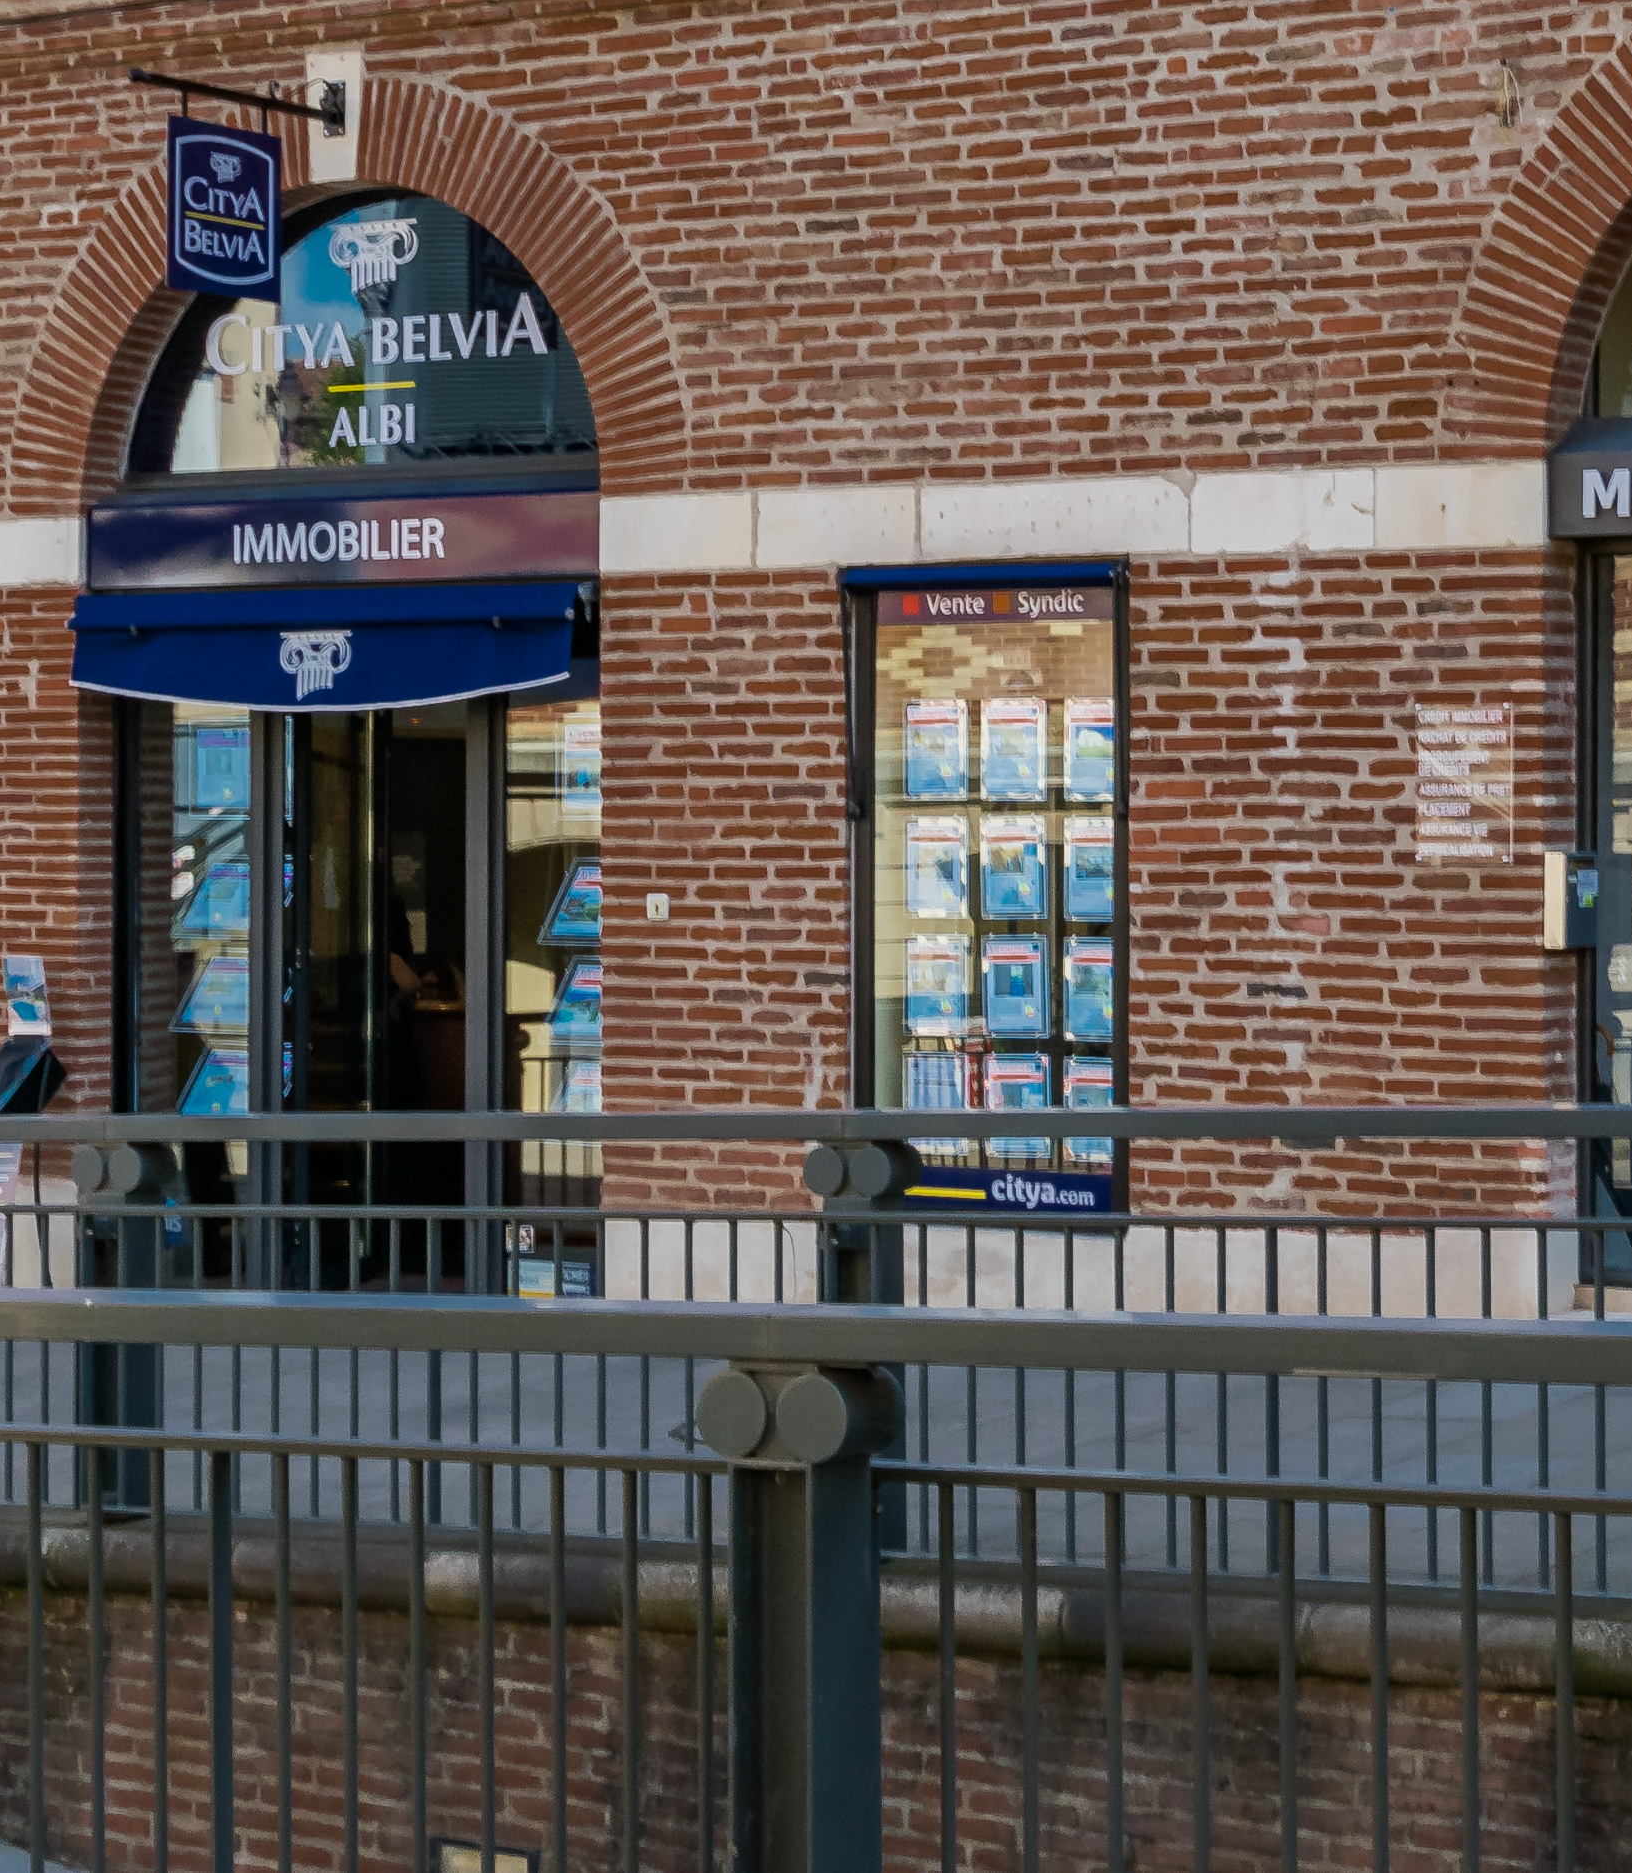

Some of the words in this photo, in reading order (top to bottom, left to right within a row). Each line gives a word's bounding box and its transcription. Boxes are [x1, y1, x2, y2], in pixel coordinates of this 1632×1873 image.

[183, 176, 265, 223] CITYA
[183, 220, 265, 266] BELVIA
[206, 313, 355, 376] CITYA
[372, 292, 548, 366] BELVIA
[329, 403, 415, 448] ALBI
[233, 518, 445, 564] IMMOBILIER
[926, 593, 985, 615] Vente
[1017, 590, 1084, 617] Syndic
[1452, 709, 1503, 723] IMMOBILIER
[1418, 731, 1453, 744] RACHAT
[1455, 731, 1467, 743] DE
[1418, 763, 1431, 776] DE
[1419, 783, 1472, 796] ASSURANCE
[1474, 784, 1485, 796] DE
[1418, 803, 1471, 817] PLACEMENT
[1419, 823, 1472, 836] ASSURANCE
[1473, 823, 1488, 837] VIE
[991, 1174, 1096, 1208] citya.com
